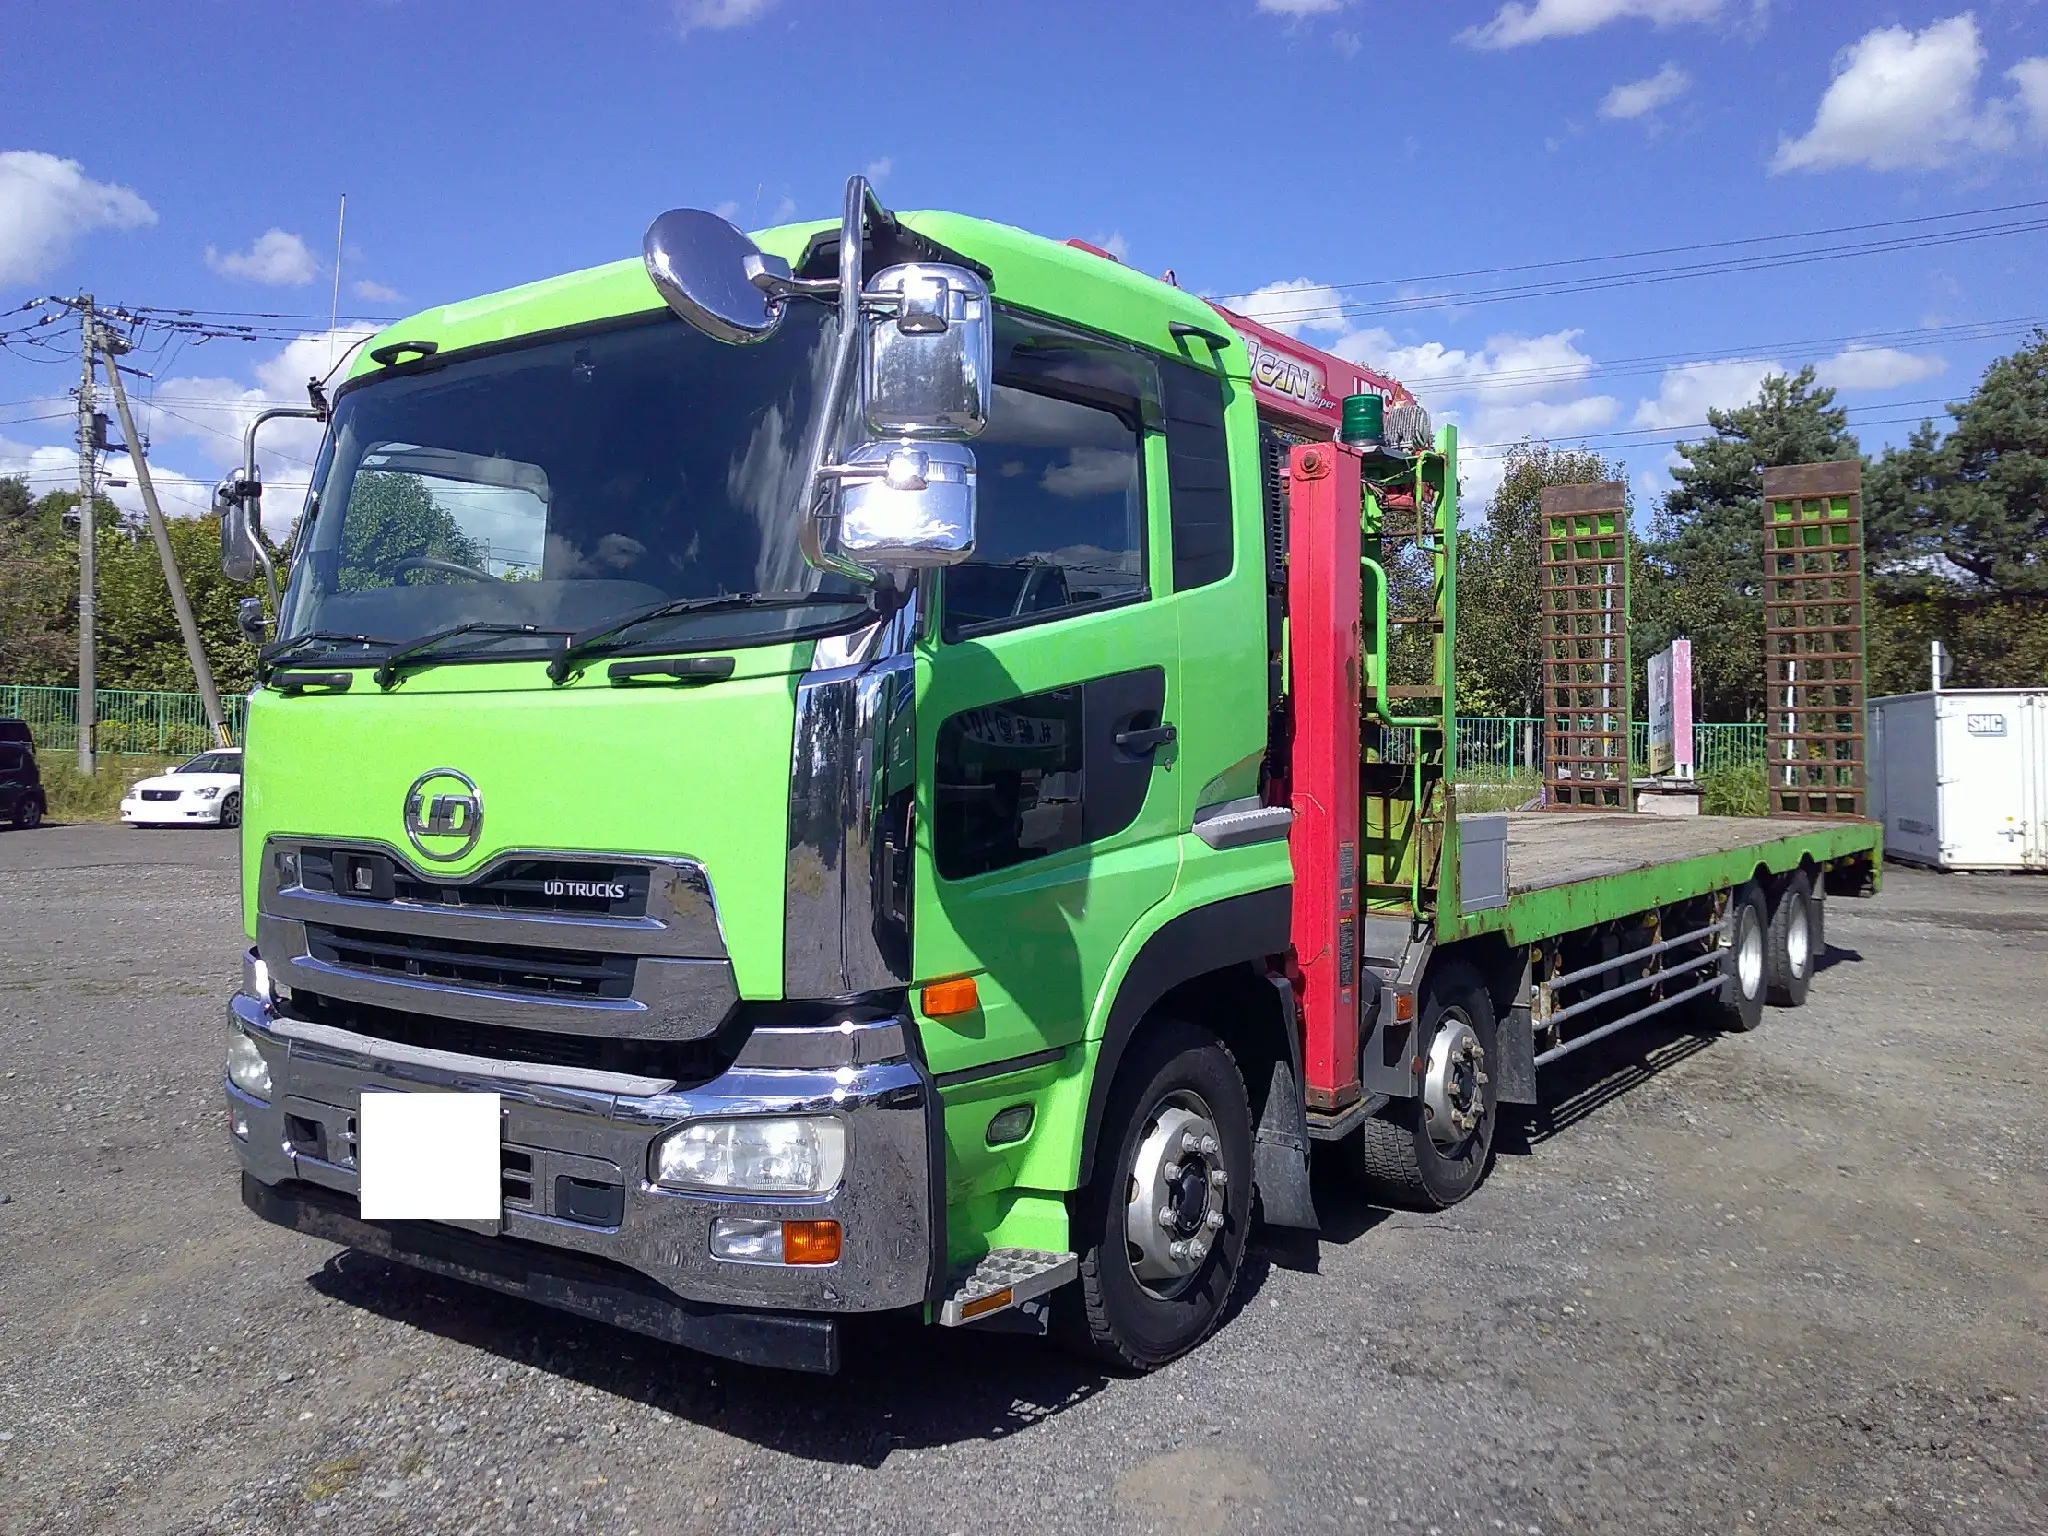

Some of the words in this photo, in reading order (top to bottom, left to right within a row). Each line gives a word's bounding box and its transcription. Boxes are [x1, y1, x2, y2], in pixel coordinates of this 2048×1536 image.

[1308, 391, 1337, 411] Super
[407, 793, 478, 837] UD
[544, 880, 564, 896] UD
[566, 881, 625, 899] TRUCKS
